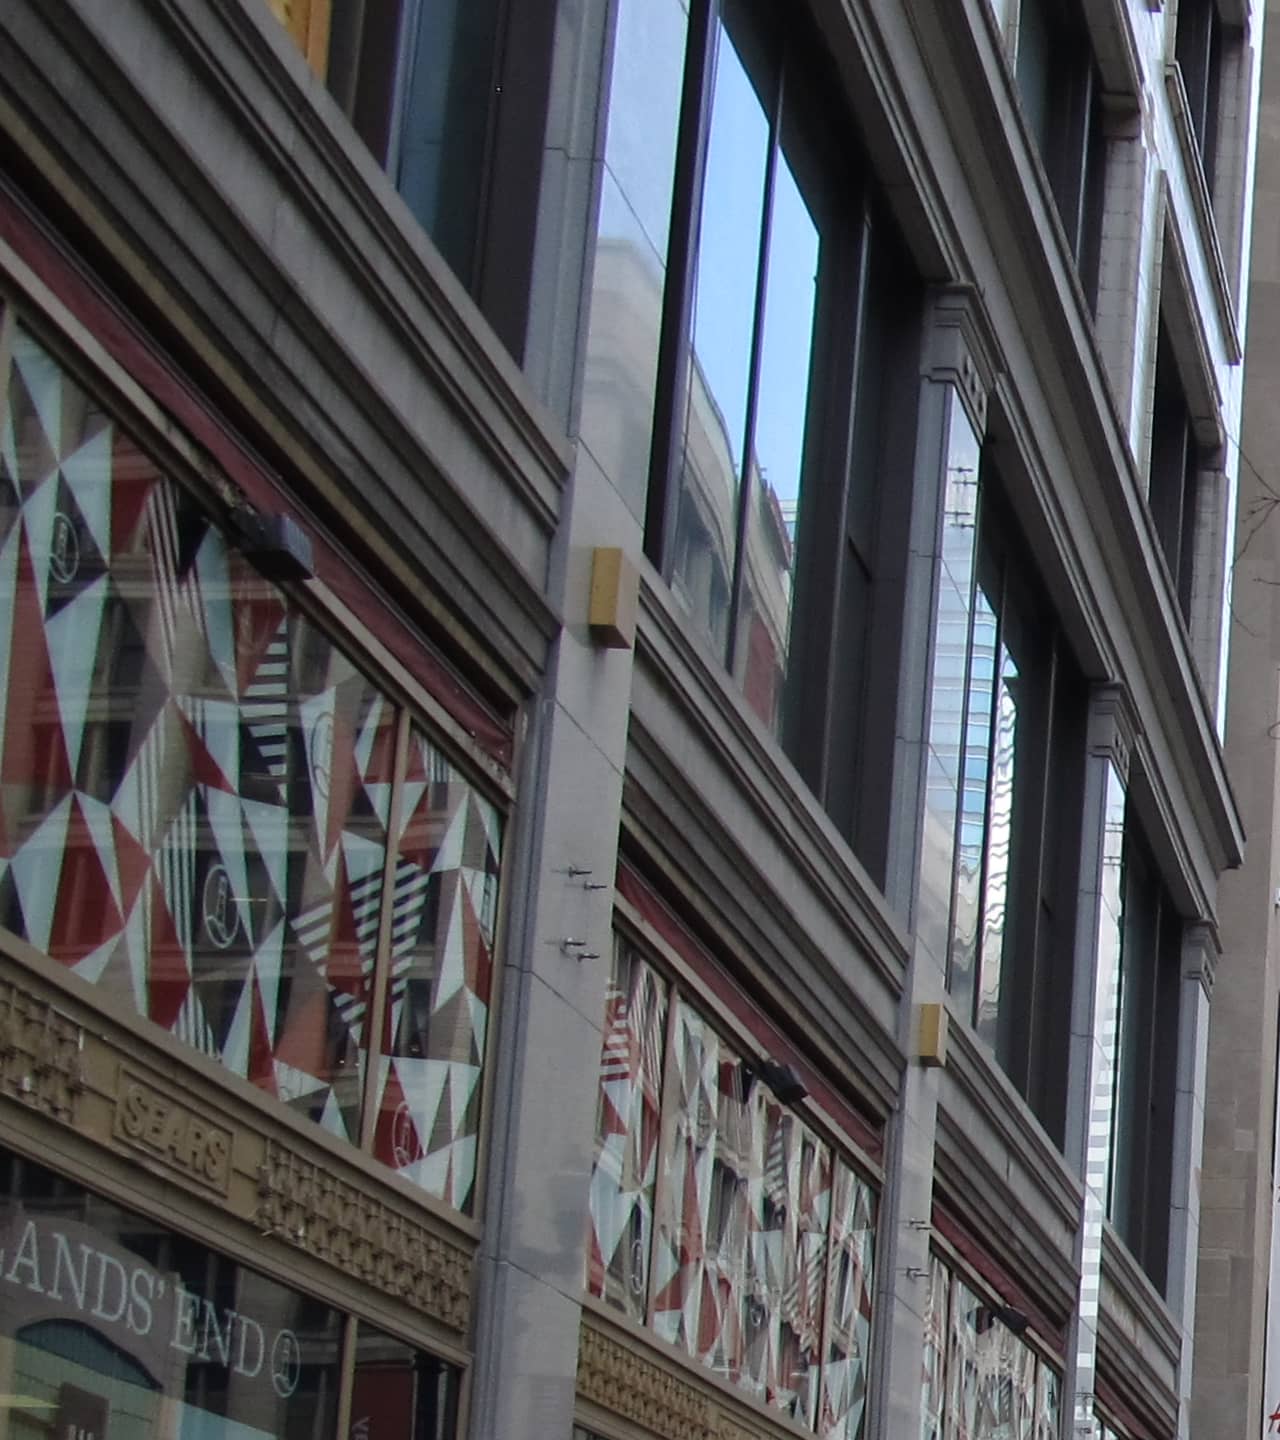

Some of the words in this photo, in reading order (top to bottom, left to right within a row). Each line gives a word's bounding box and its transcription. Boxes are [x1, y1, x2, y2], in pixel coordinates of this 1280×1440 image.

[120, 1084, 227, 1183] SEARS
[0, 1220, 168, 1337] ANDS'
[170, 1282, 266, 1378] END
